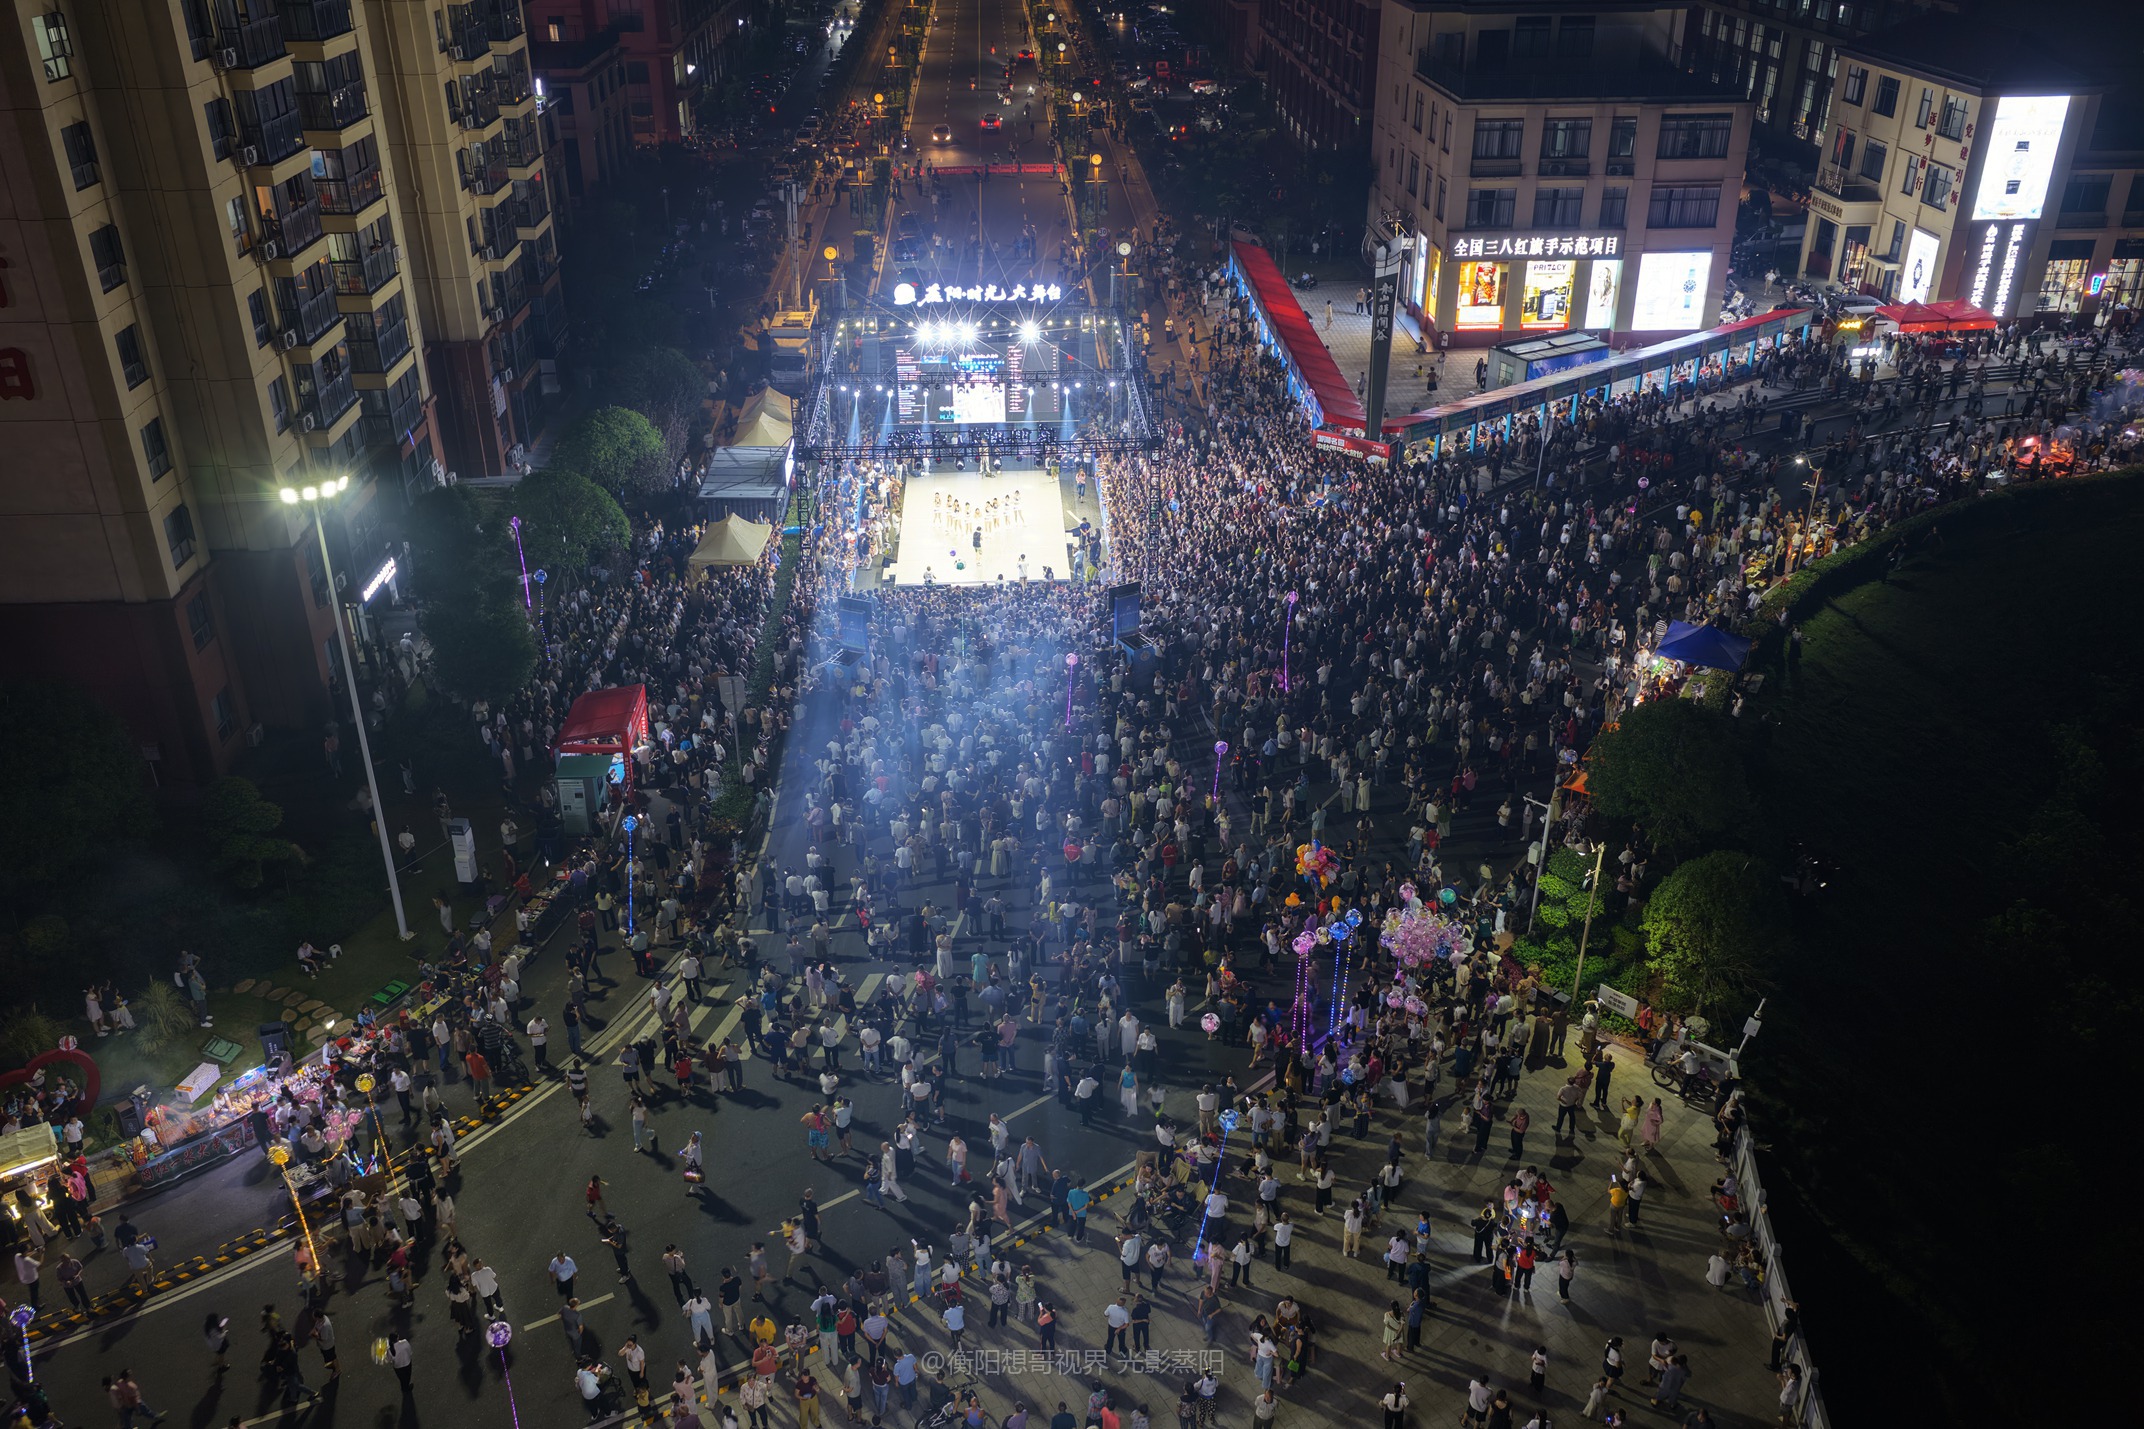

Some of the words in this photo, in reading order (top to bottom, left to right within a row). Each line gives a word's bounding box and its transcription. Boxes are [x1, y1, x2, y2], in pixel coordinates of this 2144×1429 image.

[1915, 112, 1938, 191] 逐梦前行
[1950, 123, 1974, 205] 党建引领
[1454, 236, 1619, 257] 全国三八红旗手示范项目
[141, 1136, 221, 1182] 网红一米大串
